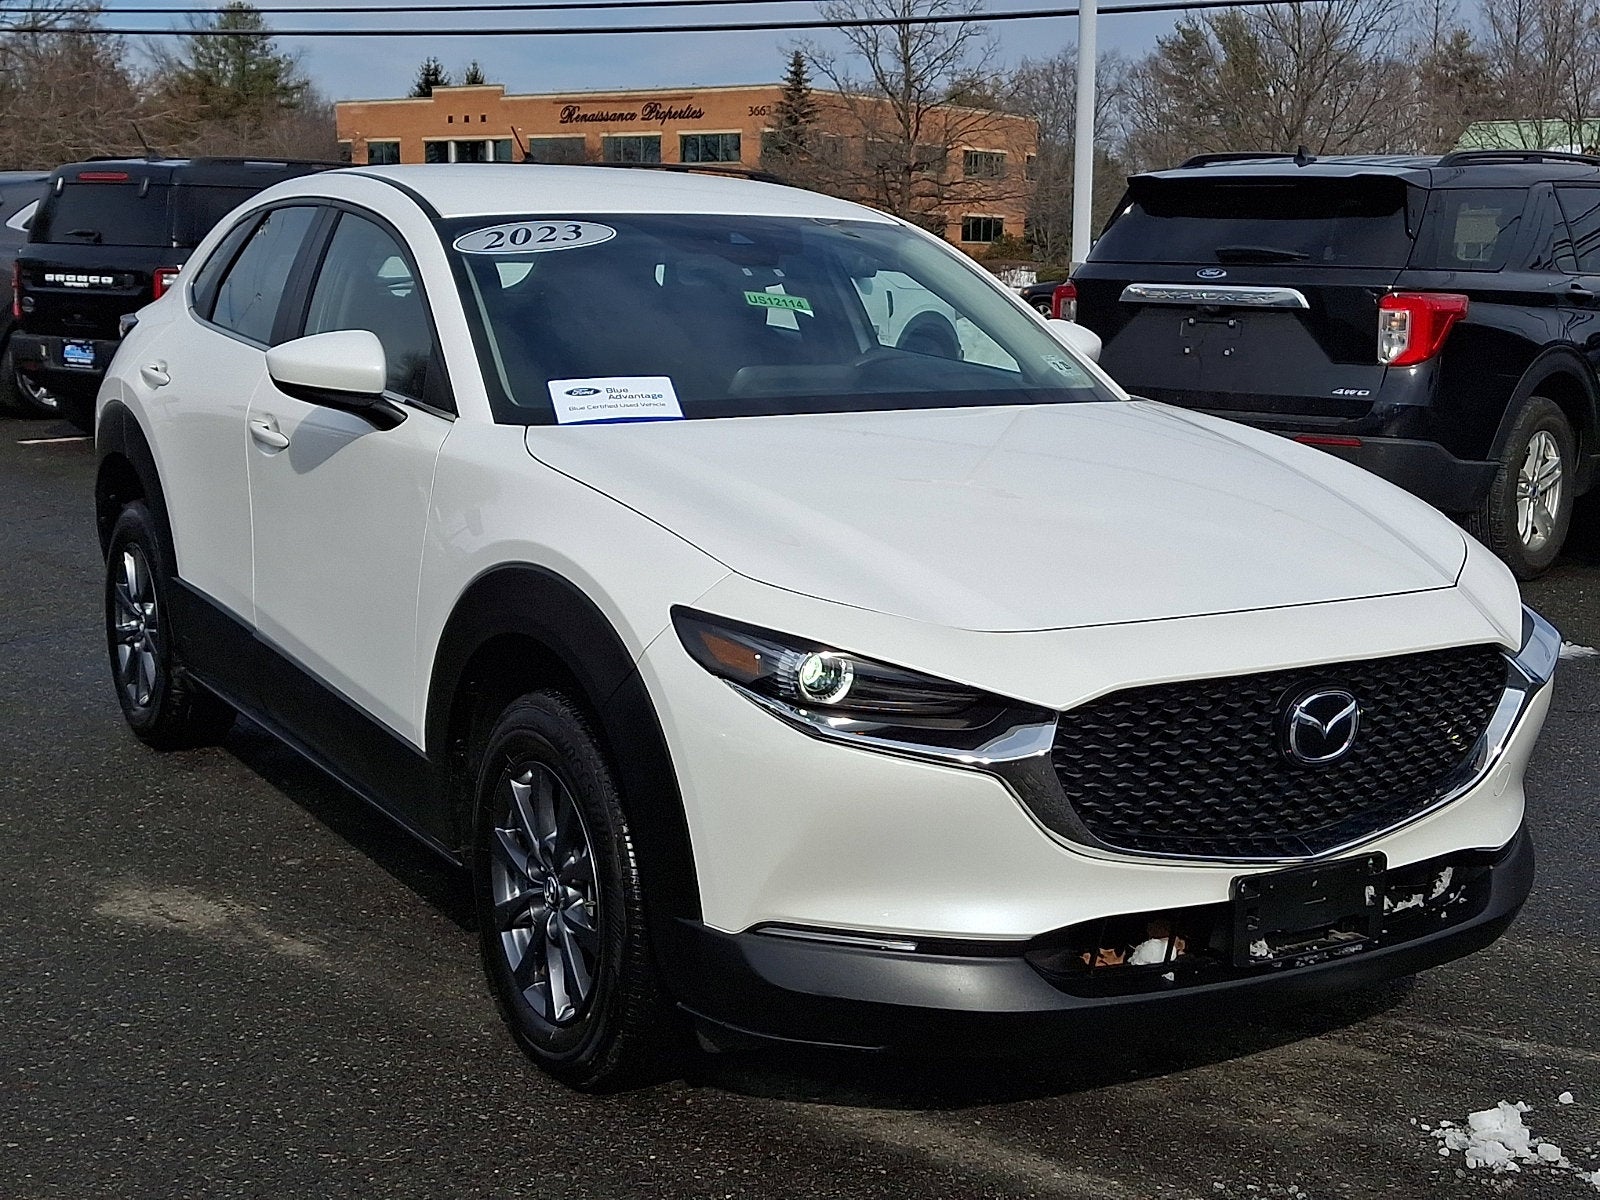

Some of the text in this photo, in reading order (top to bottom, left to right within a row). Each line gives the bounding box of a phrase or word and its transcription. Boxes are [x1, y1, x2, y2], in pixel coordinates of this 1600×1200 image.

[559, 102, 705, 126] Renaissance Properties
[483, 224, 583, 250] 2023
[747, 294, 804, 309] US12114
[608, 393, 664, 401] Advantage
